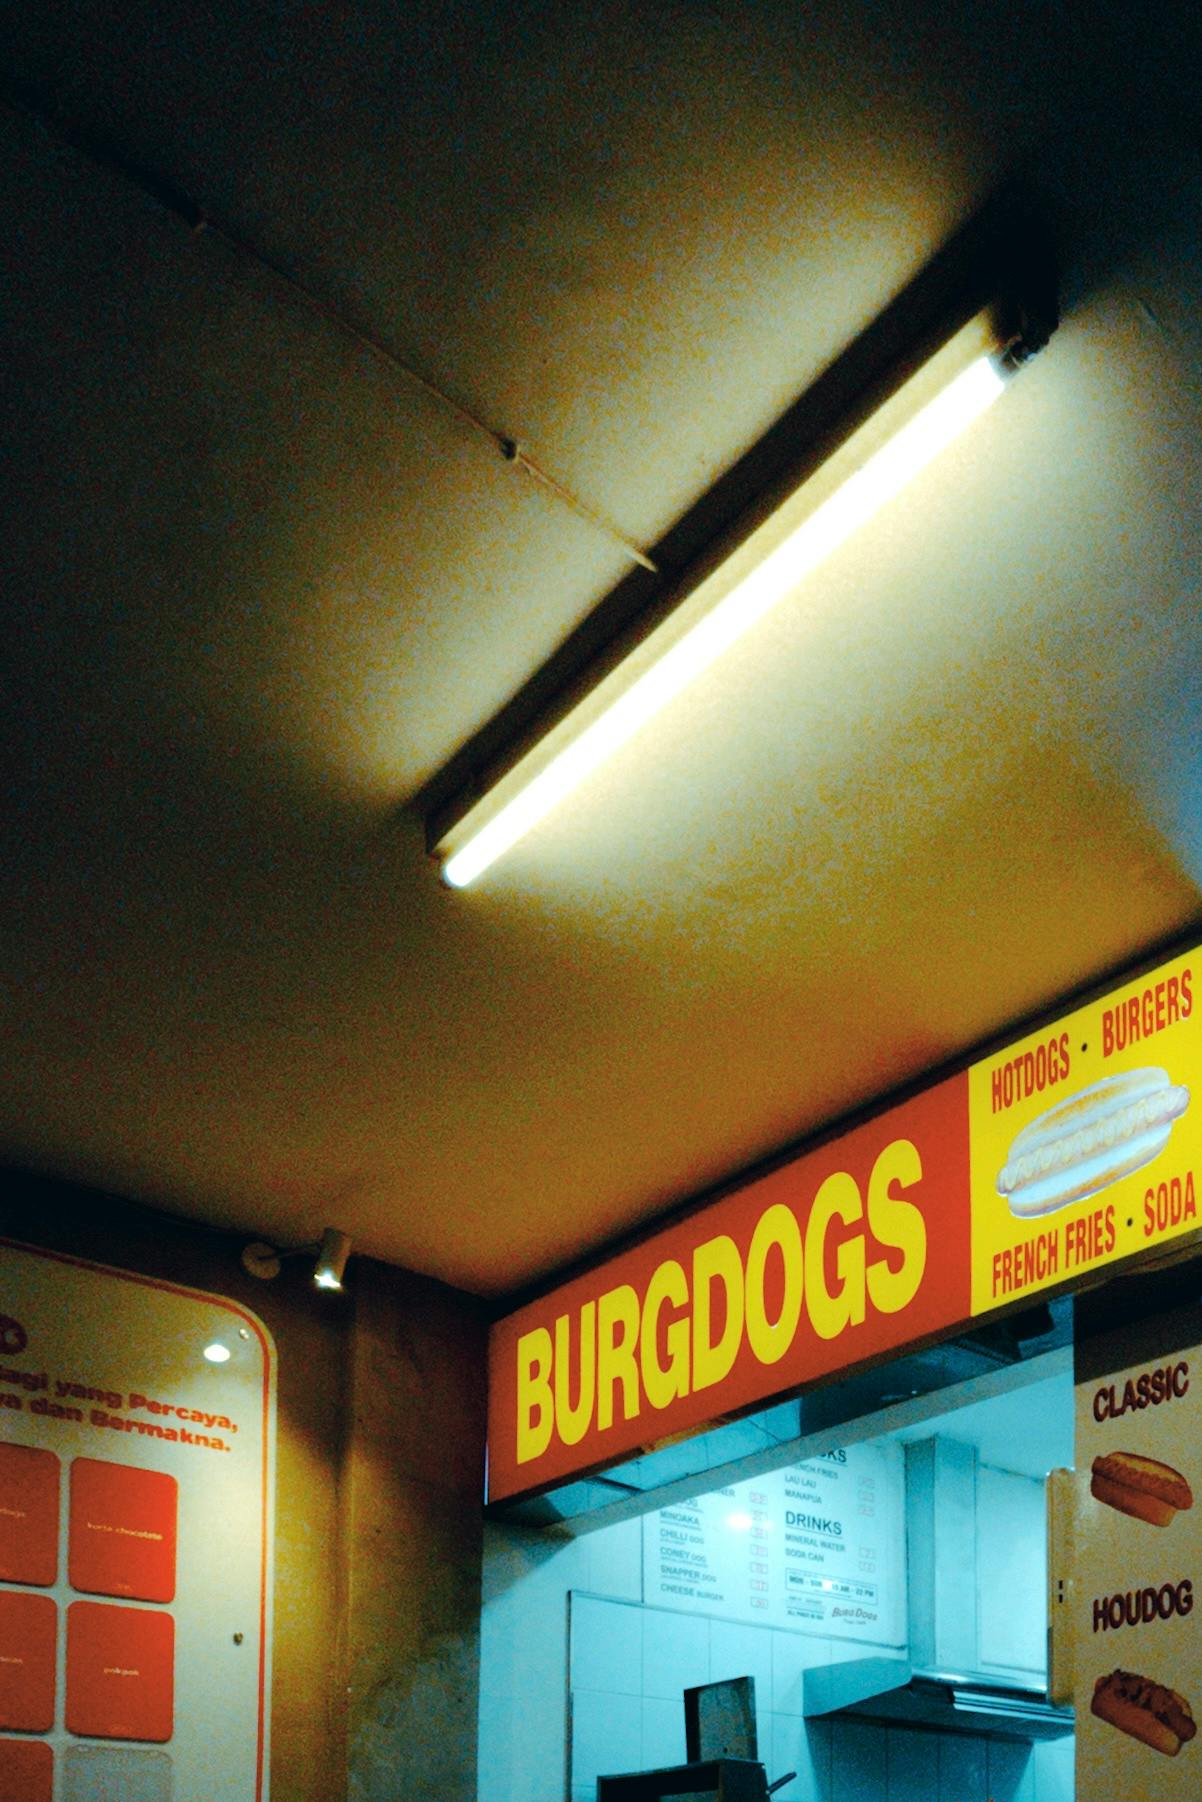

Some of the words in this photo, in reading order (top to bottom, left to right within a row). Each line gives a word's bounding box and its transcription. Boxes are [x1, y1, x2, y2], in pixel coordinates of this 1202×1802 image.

[991, 1032, 1069, 1113] HOTDOGS
[1102, 968, 1193, 1058] BURGERS
[991, 1236, 1058, 1299] FRENCH
[1066, 1204, 1116, 1279] FRIES
[1142, 1171, 1197, 1234] SODA
[516, 1139, 927, 1466] BURGDOGS
[56, 1380, 122, 1409] yang
[129, 1392, 238, 1433] Percaya,
[1092, 1361, 1191, 1422] CLASSIC
[30, 1399, 83, 1423] dan
[91, 1408, 230, 1452] Bermakna.
[785, 1511, 842, 1536] DRINKS
[1093, 1579, 1193, 1633] HOUDOG
